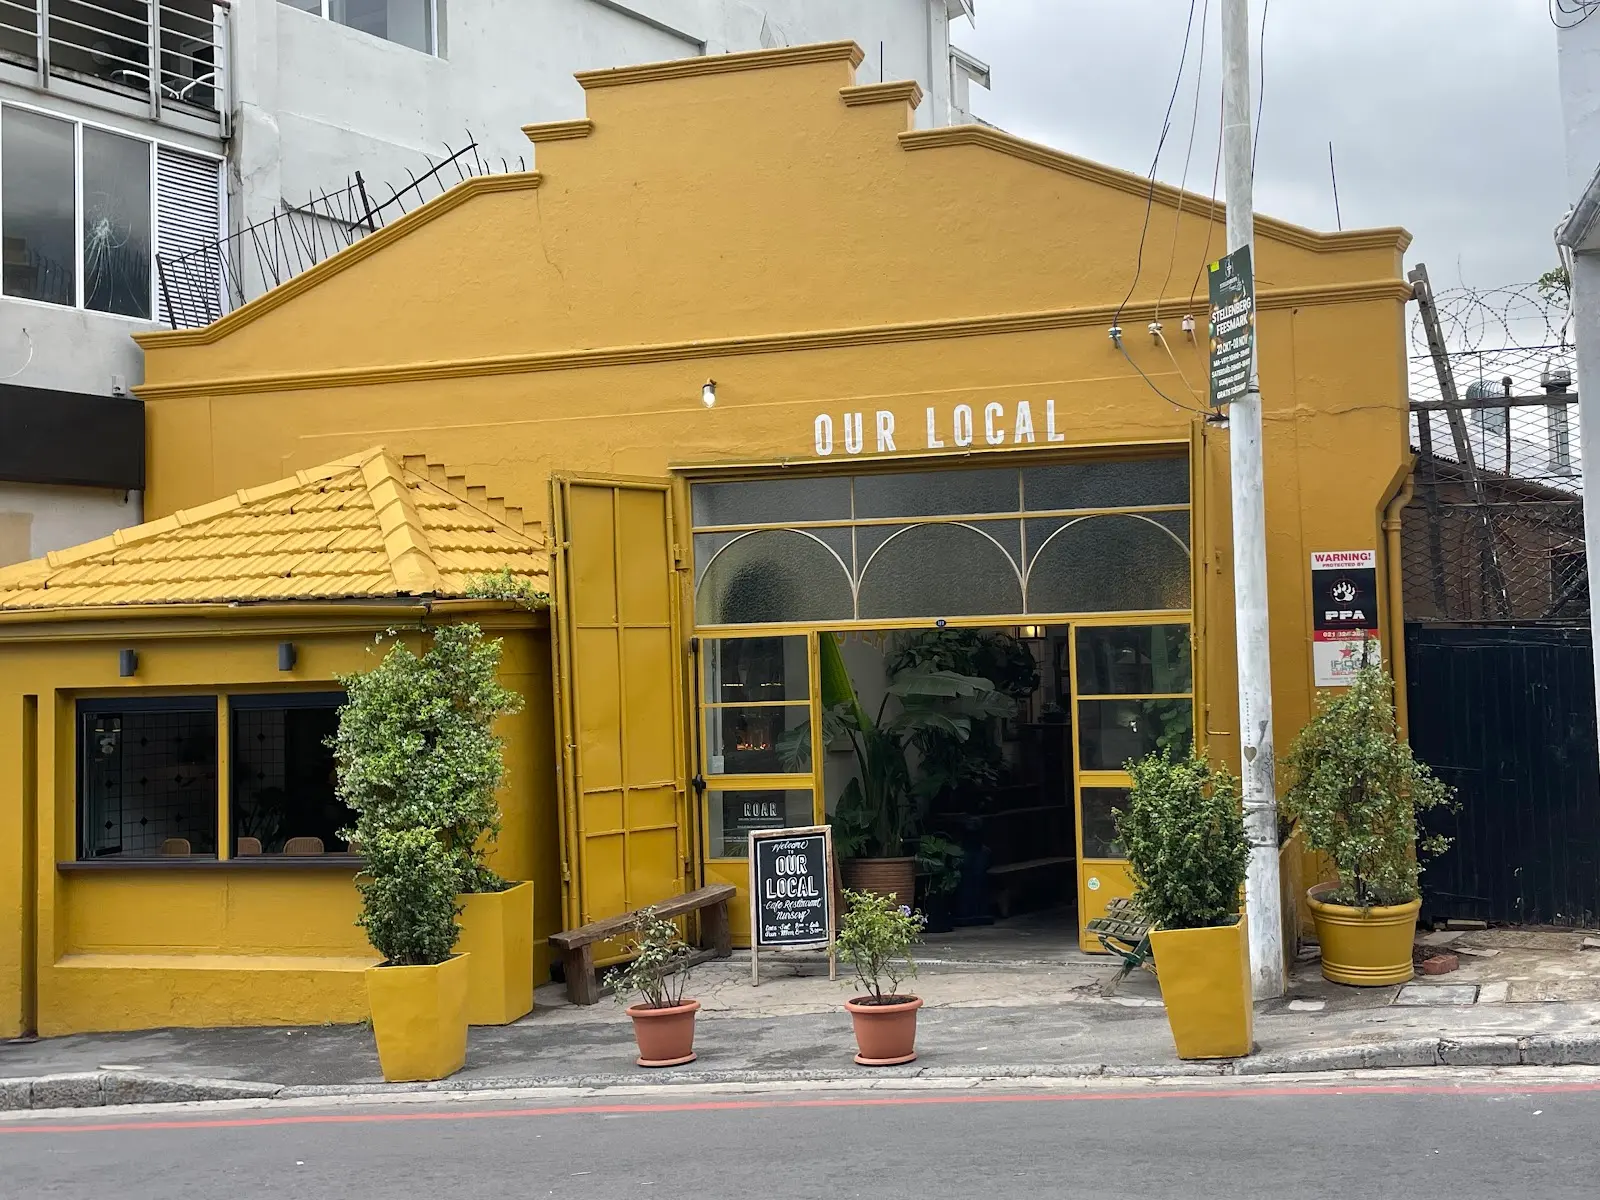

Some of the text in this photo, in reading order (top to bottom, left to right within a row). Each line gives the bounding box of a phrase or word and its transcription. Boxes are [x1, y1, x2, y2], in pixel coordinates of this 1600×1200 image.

[1212, 297, 1251, 323] STELLENBERG
[1216, 314, 1248, 336] FEESMARK
[814, 399, 1065, 456] OUR LOCAL
[1315, 552, 1371, 562] WARNING!
[1325, 610, 1366, 621] PPA
[743, 802, 777, 817] ROAR
[771, 840, 809, 853] Welcome
[775, 854, 808, 876] OUR
[766, 876, 819, 899] LOCAL
[776, 909, 810, 922] Nursery
